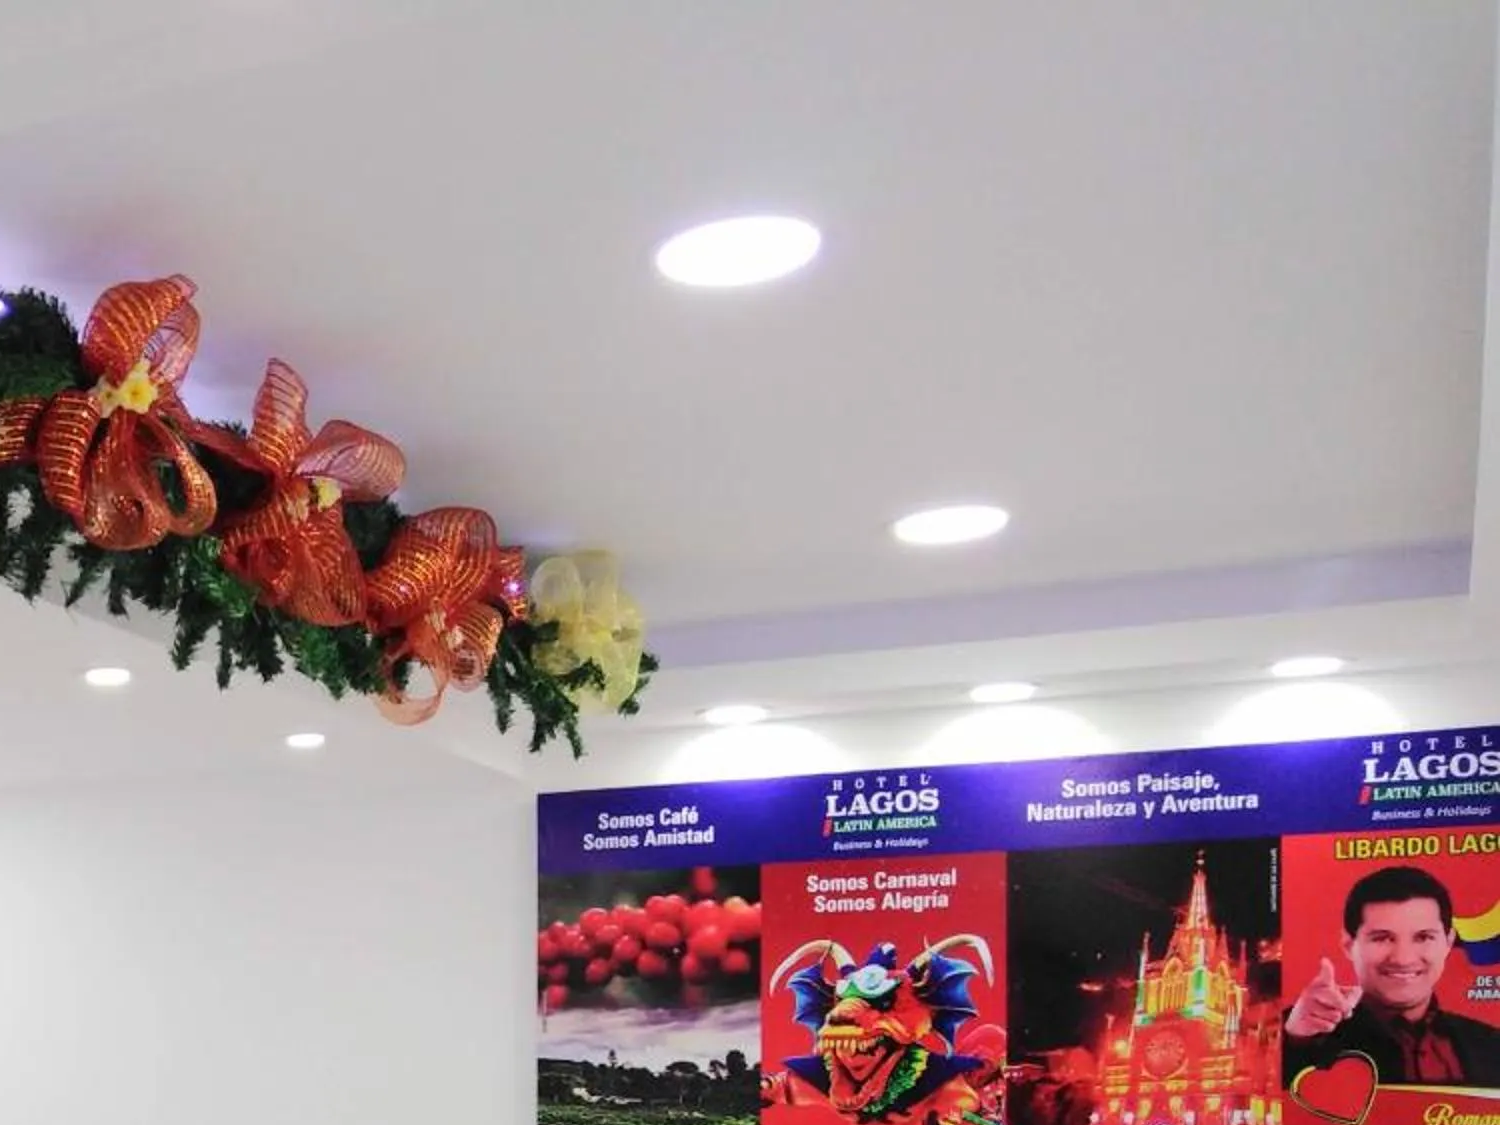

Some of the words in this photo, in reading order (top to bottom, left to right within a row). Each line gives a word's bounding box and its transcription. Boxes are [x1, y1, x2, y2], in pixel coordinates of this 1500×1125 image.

[1371, 734, 1493, 755] HOTEL
[1363, 751, 1500, 783] LAGOS
[832, 774, 931, 791] HOTEL
[1061, 778, 1131, 799] Somos
[1137, 770, 1220, 794] Paisaje,
[1373, 785, 1422, 801] LATIN
[825, 788, 940, 818] LAGOS
[1027, 801, 1137, 823] Naturaleza
[1143, 801, 1157, 819] y
[1161, 794, 1259, 815] Aventura
[598, 813, 655, 830] Somos
[659, 805, 699, 826] Café
[833, 819, 874, 833] LATIN
[876, 815, 937, 831] AMERICA
[583, 833, 640, 851] Somos
[643, 825, 716, 847] Amistad
[1335, 835, 1440, 860] LIBARDO
[1449, 832, 1500, 855] LAG
[806, 874, 869, 894] Somos
[874, 867, 957, 890] Carnaval
[814, 895, 877, 913] Somos
[881, 889, 950, 913] Alegría
